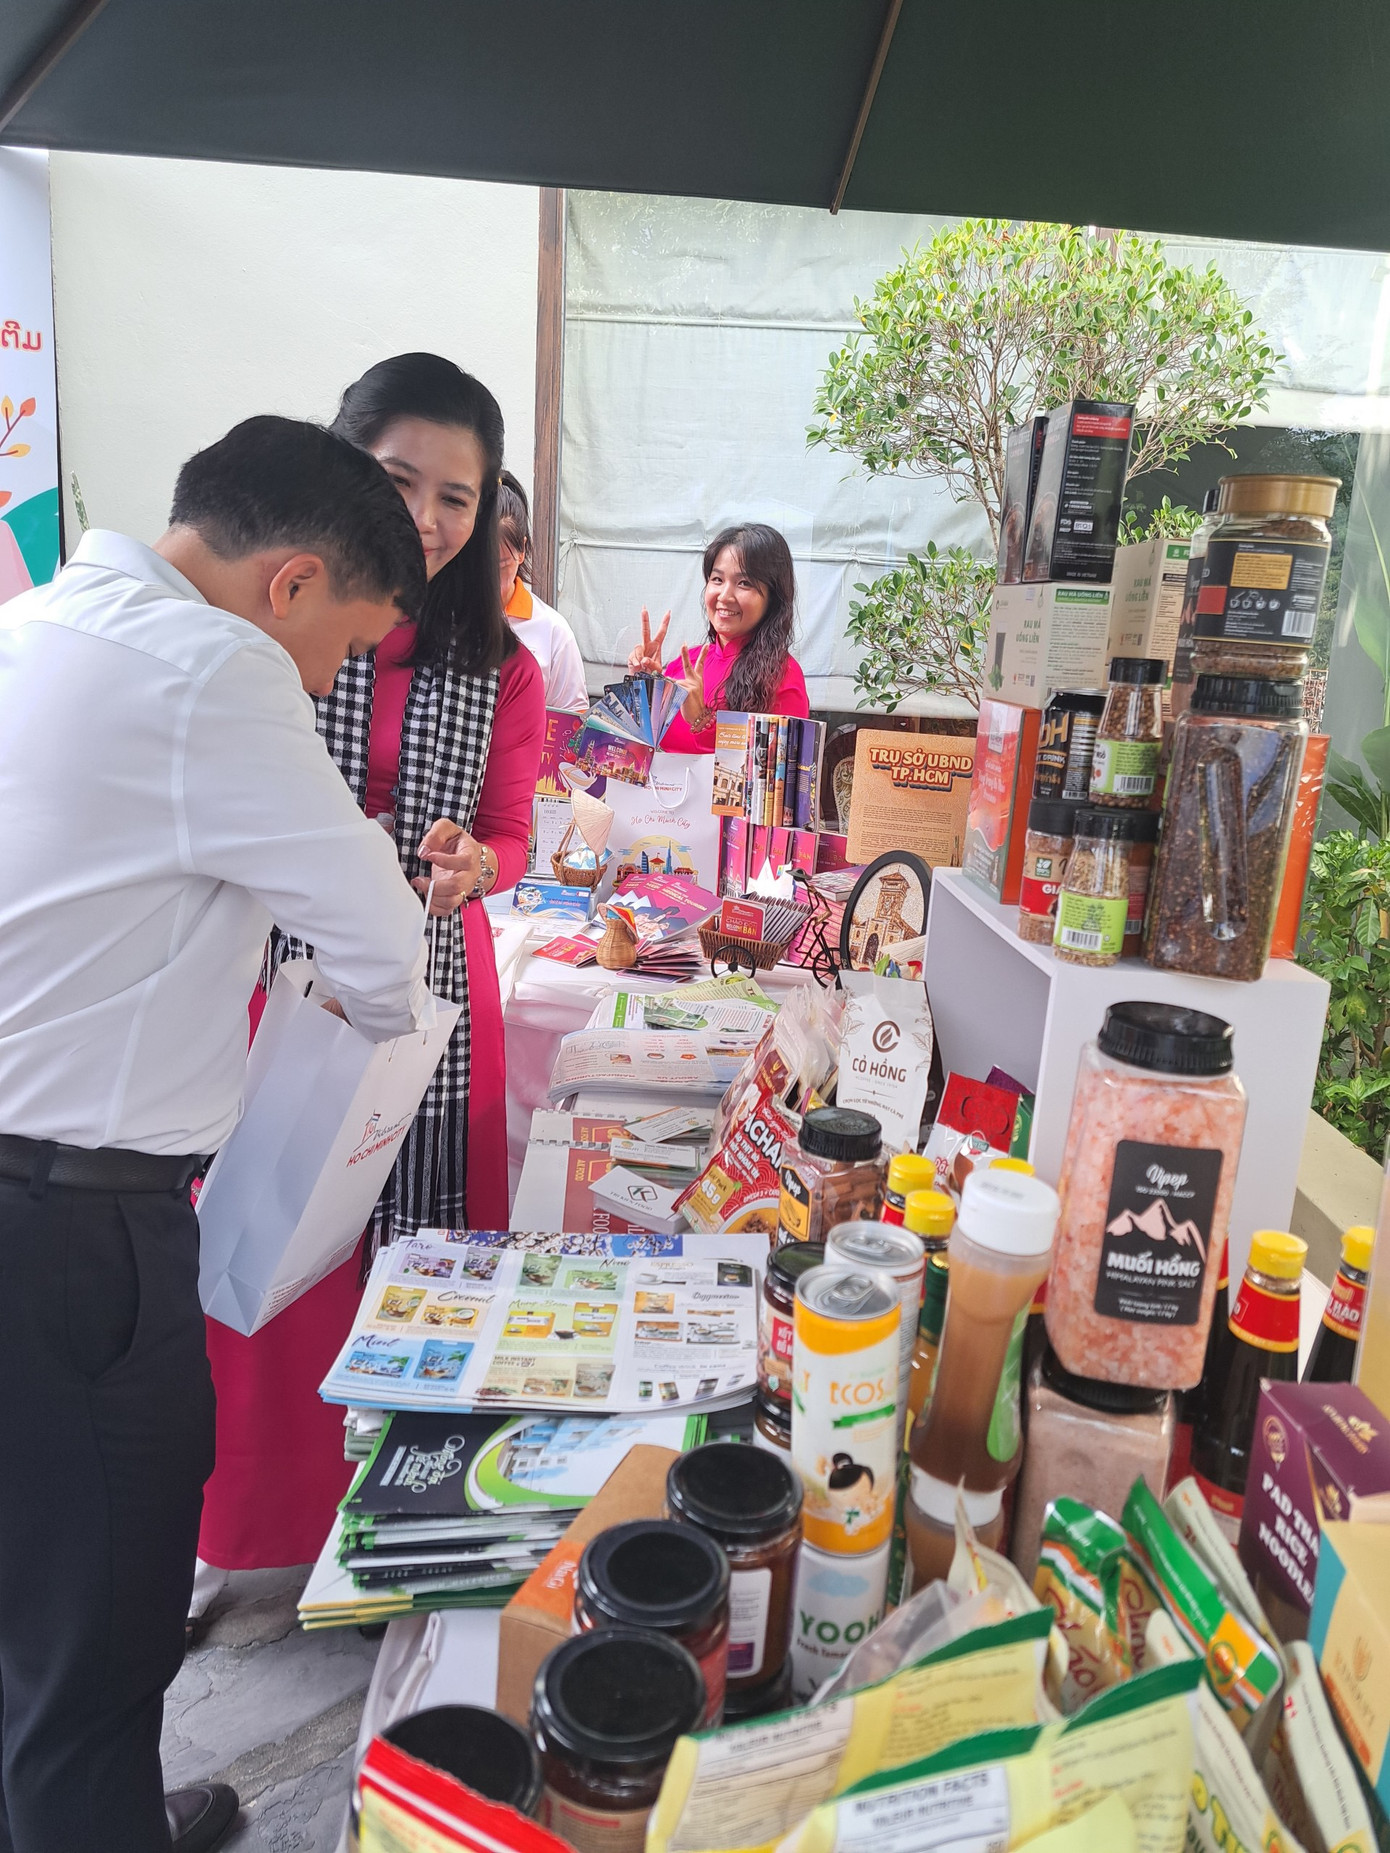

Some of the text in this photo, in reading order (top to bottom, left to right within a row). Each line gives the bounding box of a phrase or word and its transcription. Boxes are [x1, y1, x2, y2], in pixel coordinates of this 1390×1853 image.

[870, 747, 974, 772] TRỤ SỞ UBND
[891, 765, 952, 786] TP.HCM
[852, 1054, 867, 1073] CỎ
[700, 1178, 717, 1199] 45
[1106, 1250, 1201, 1278] MUỐI HỒNG
[1105, 1270, 1197, 1289] HIMALAYAN PINK SALT
[1261, 1471, 1294, 1517] PAD
[1274, 1513, 1309, 1568] RICE
[855, 1772, 990, 1813] NUTRITION FACTS
